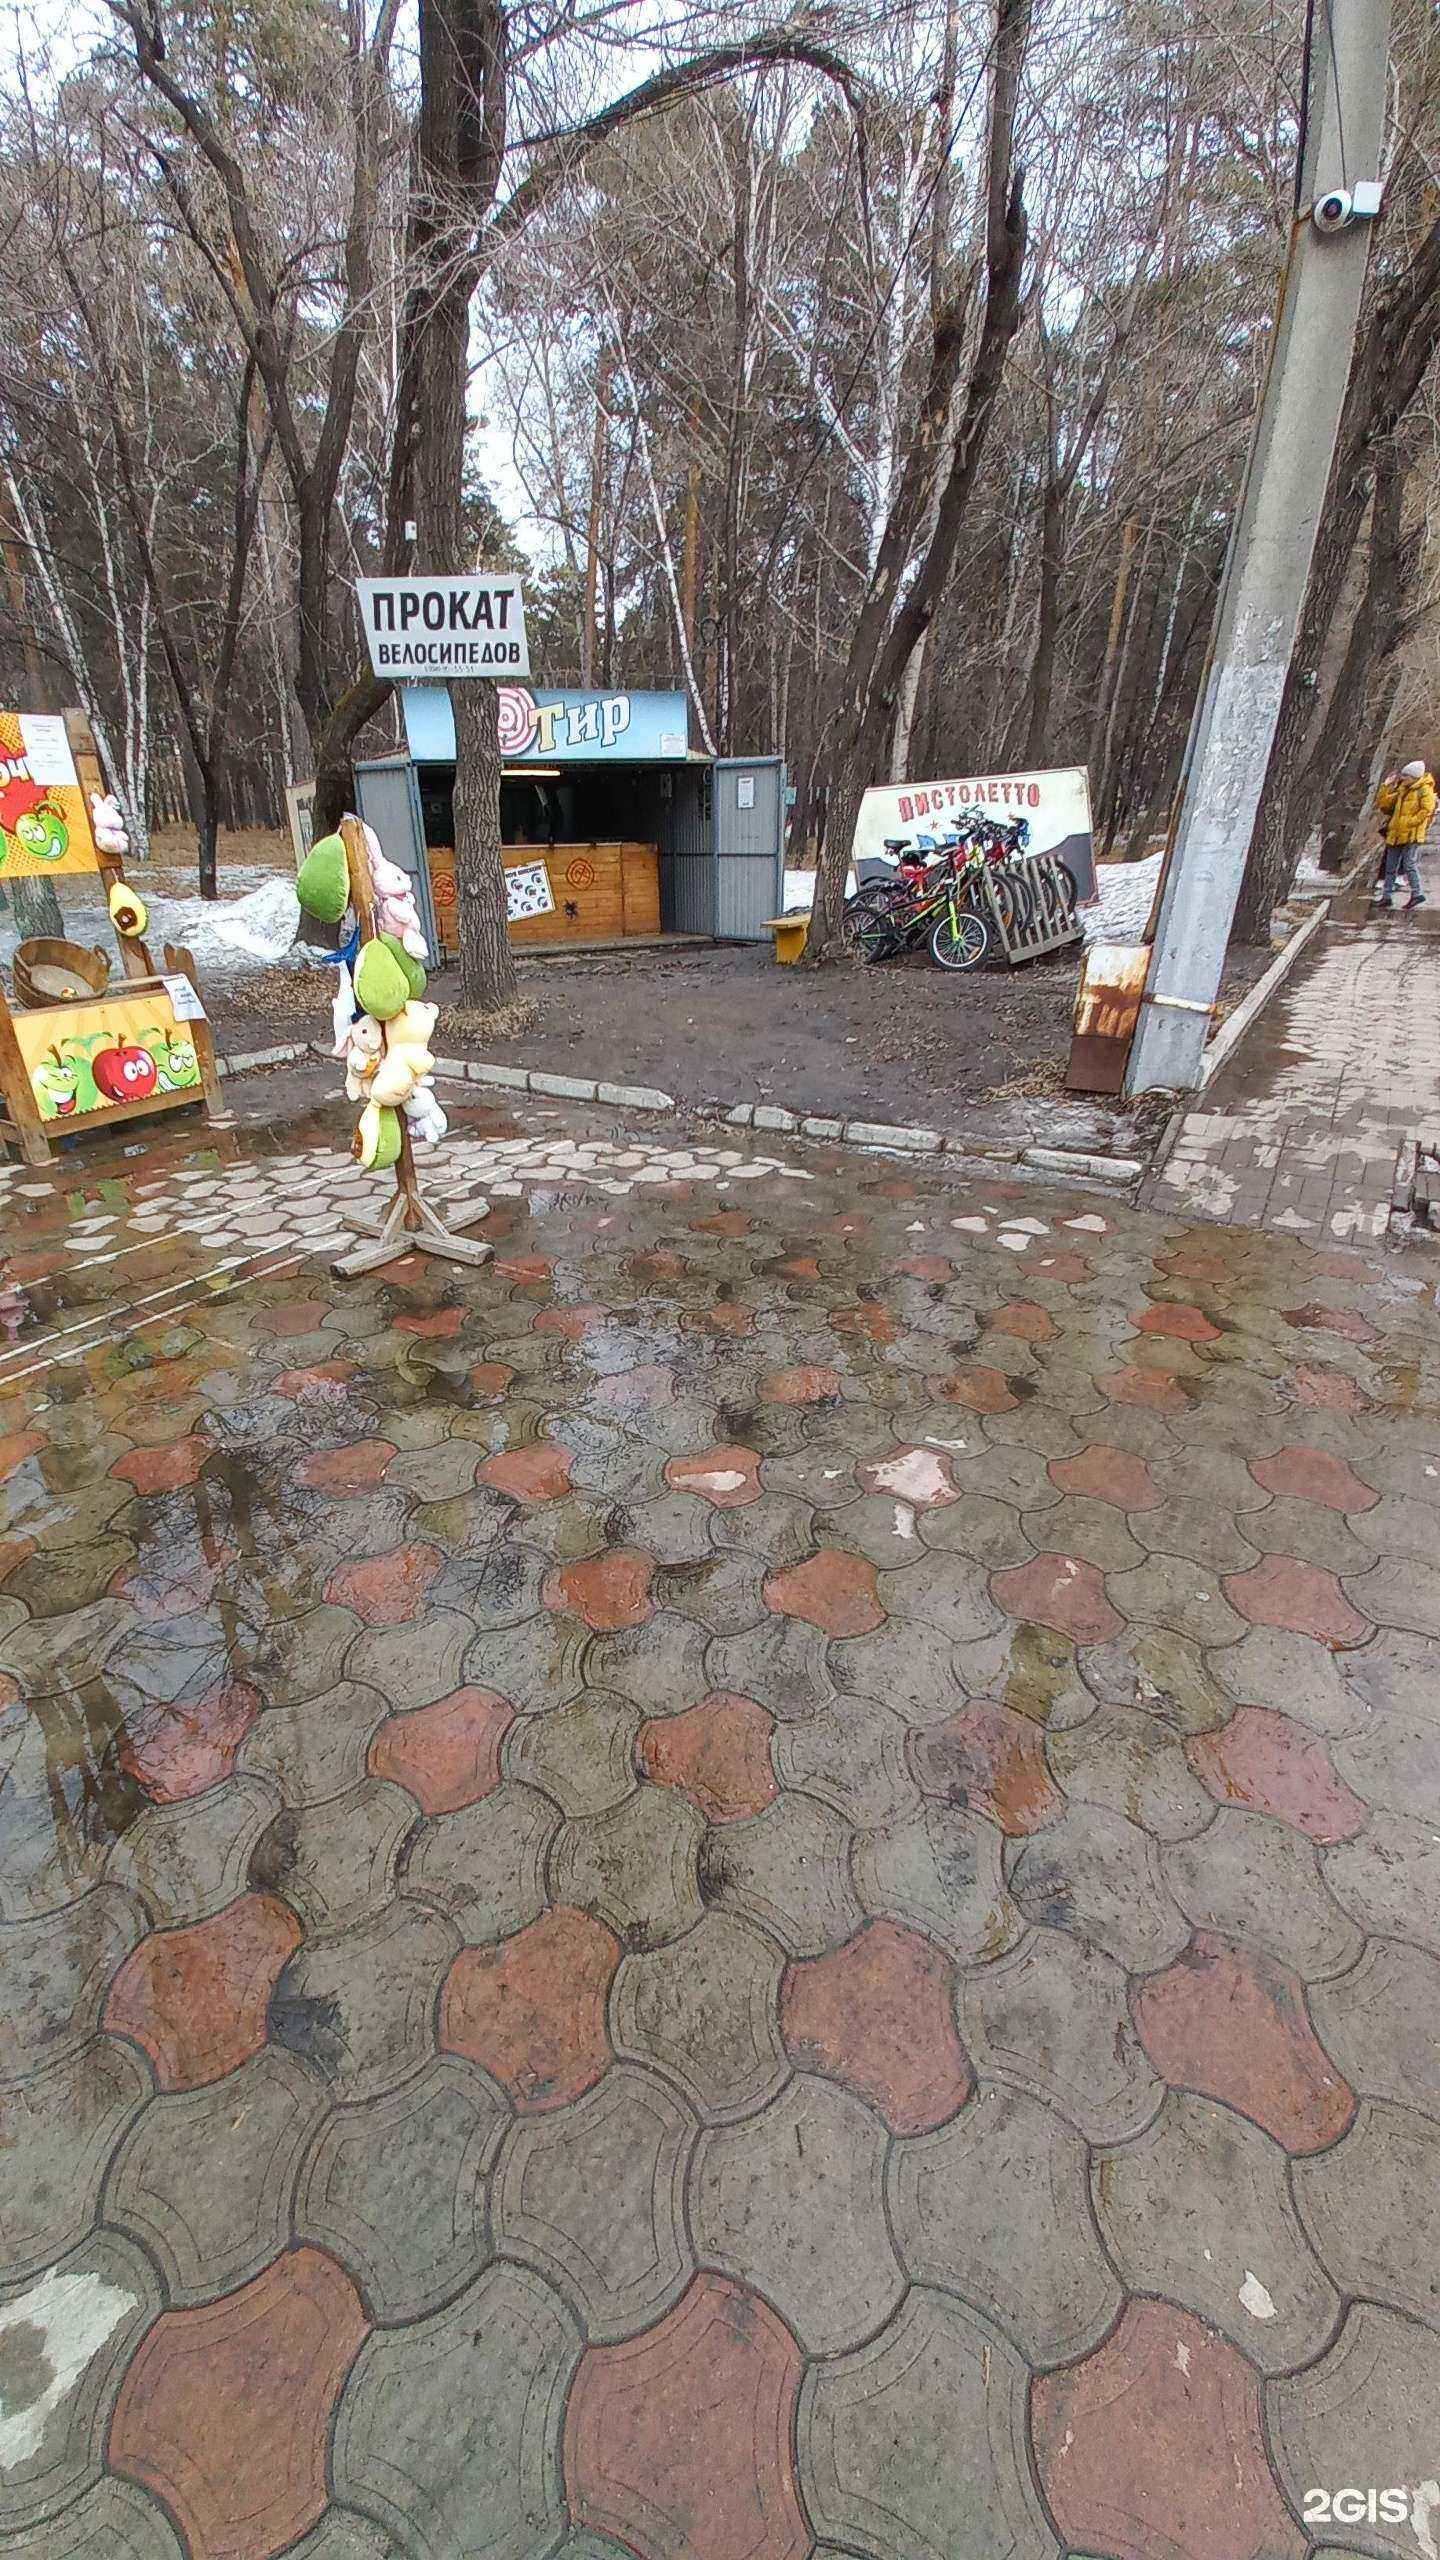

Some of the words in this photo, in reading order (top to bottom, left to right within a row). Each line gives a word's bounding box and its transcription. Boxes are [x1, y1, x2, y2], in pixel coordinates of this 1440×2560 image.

[372, 589, 514, 631] ПРОКАТ
[378, 642, 521, 665] ВЕЛОСИПЕДОВ
[528, 695, 631, 753] Тир
[899, 782, 1040, 822] ПИСТОЛЕТТО
